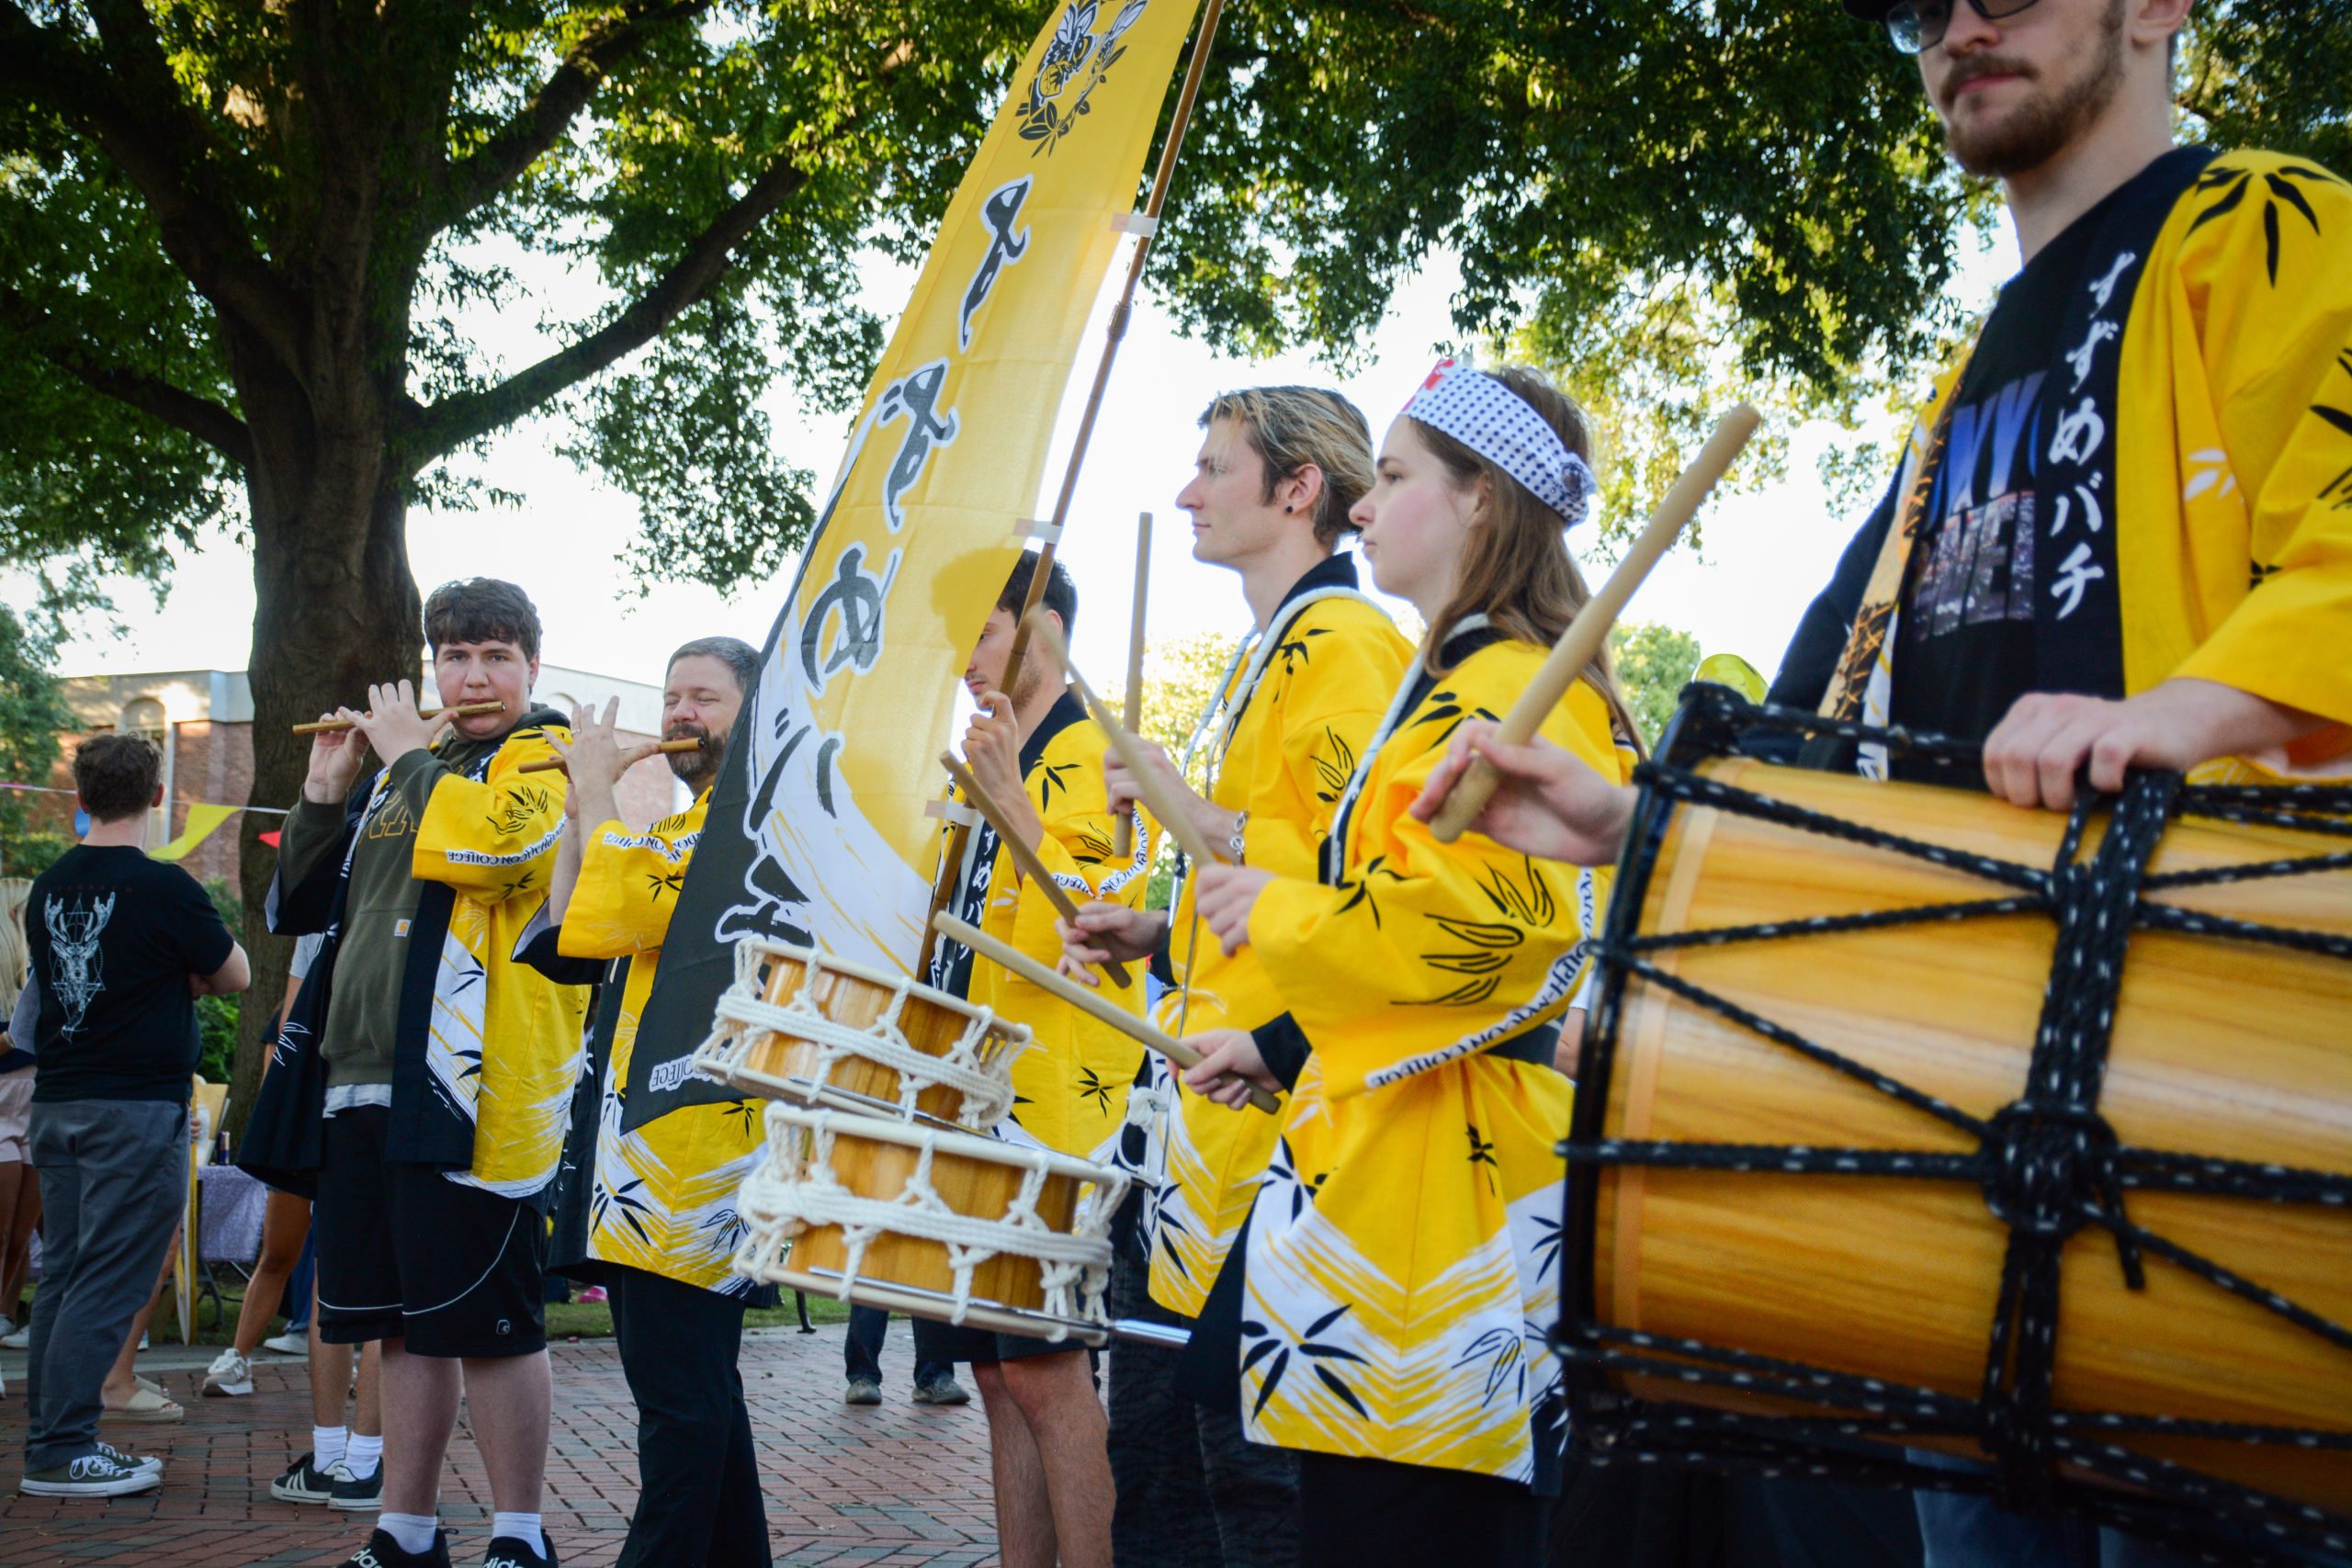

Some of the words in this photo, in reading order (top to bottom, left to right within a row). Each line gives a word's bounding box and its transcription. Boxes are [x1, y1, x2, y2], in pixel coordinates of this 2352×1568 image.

[2049, 251, 2136, 621] すずめバチ
